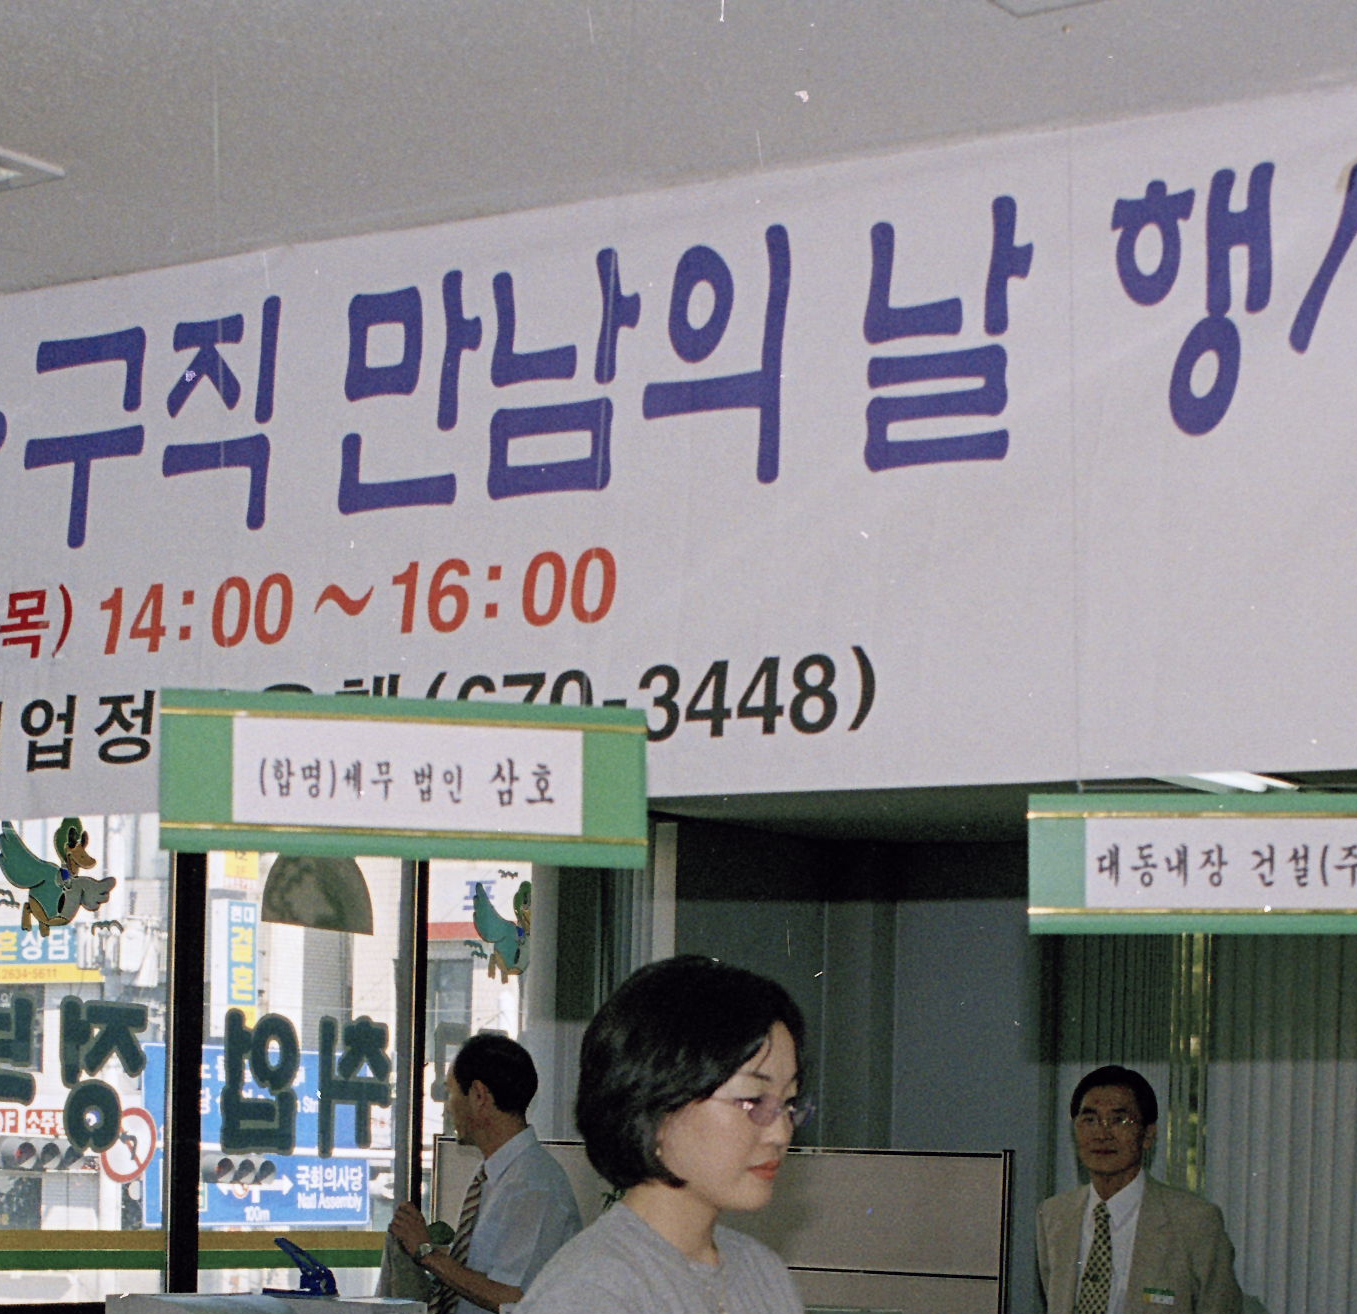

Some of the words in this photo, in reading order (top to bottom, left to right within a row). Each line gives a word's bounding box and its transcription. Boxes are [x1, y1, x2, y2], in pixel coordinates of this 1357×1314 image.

[338, 223, 792, 515] 만남의
[862, 194, 1035, 474] 날
[488, 760, 557, 808] 삼호
[1096, 842, 1229, 888] 대동내장
[296, 1164, 364, 1192] 국회의사당
